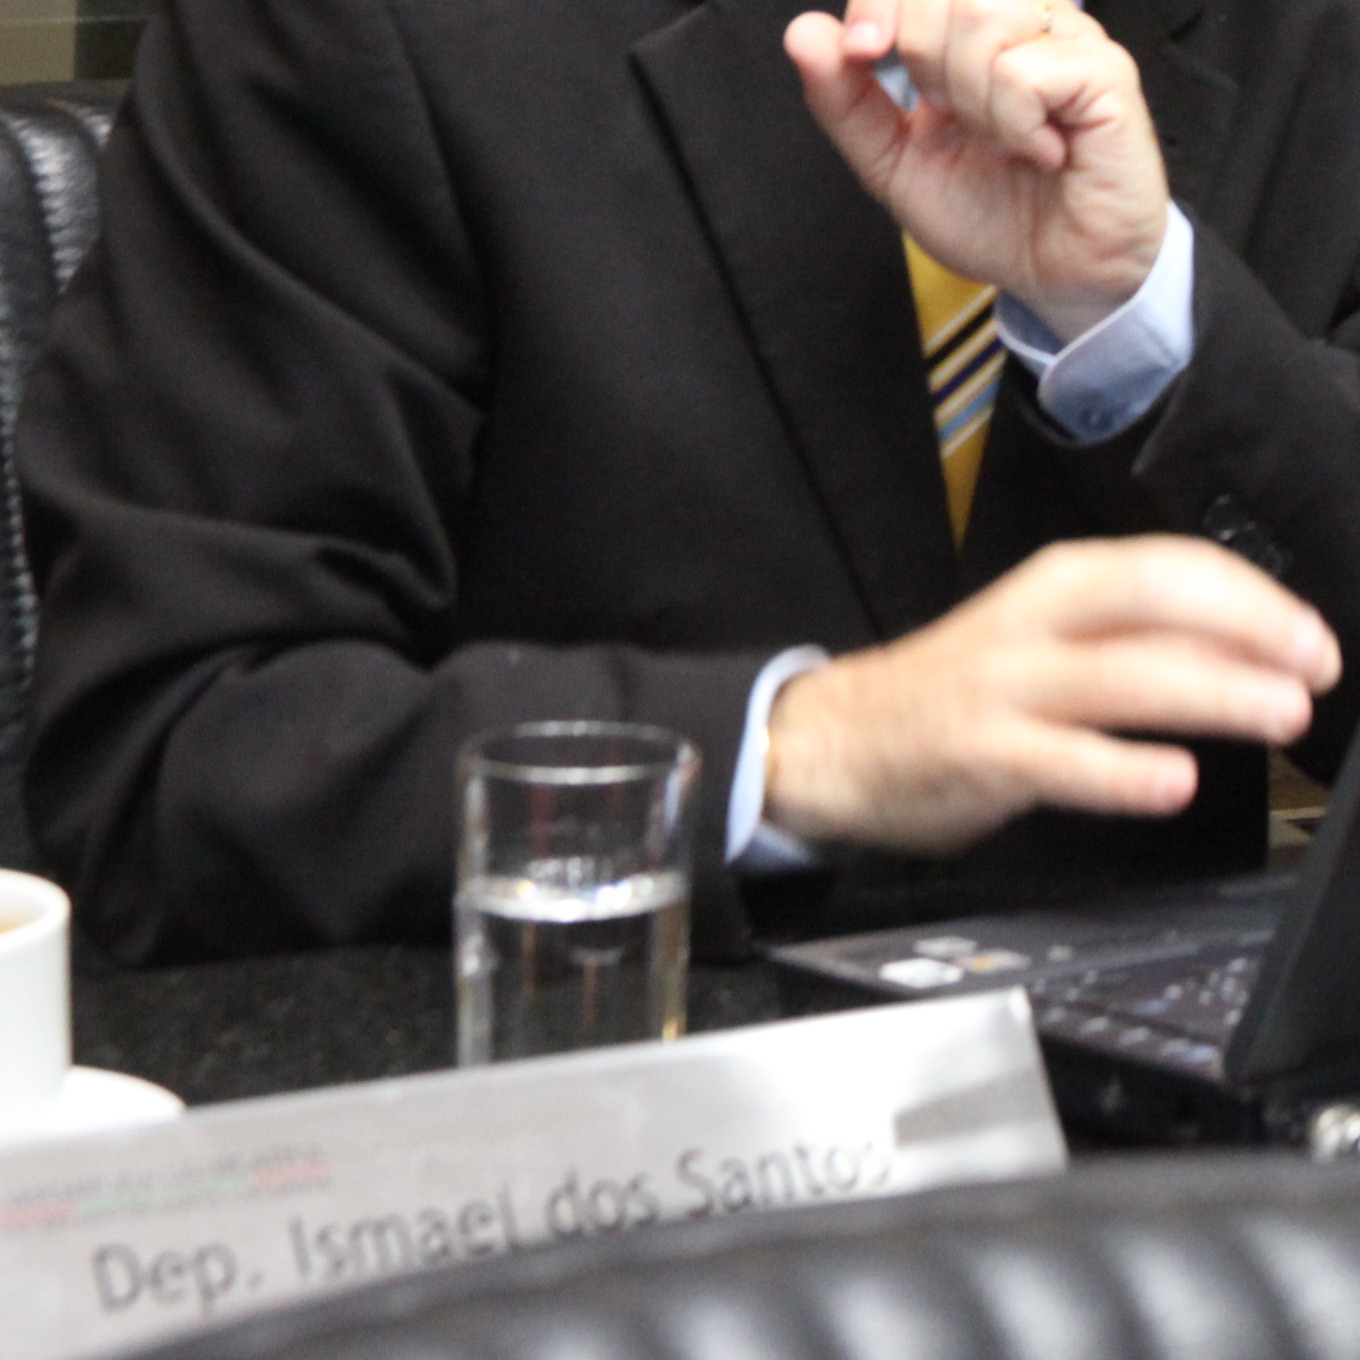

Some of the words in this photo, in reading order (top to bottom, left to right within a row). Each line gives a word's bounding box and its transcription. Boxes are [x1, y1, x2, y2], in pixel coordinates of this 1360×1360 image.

[91, 1241, 265, 1317] Dep.
[287, 1181, 516, 1279] Ismael
[545, 1165, 660, 1239] dos
[676, 1142, 890, 1219] Santos
